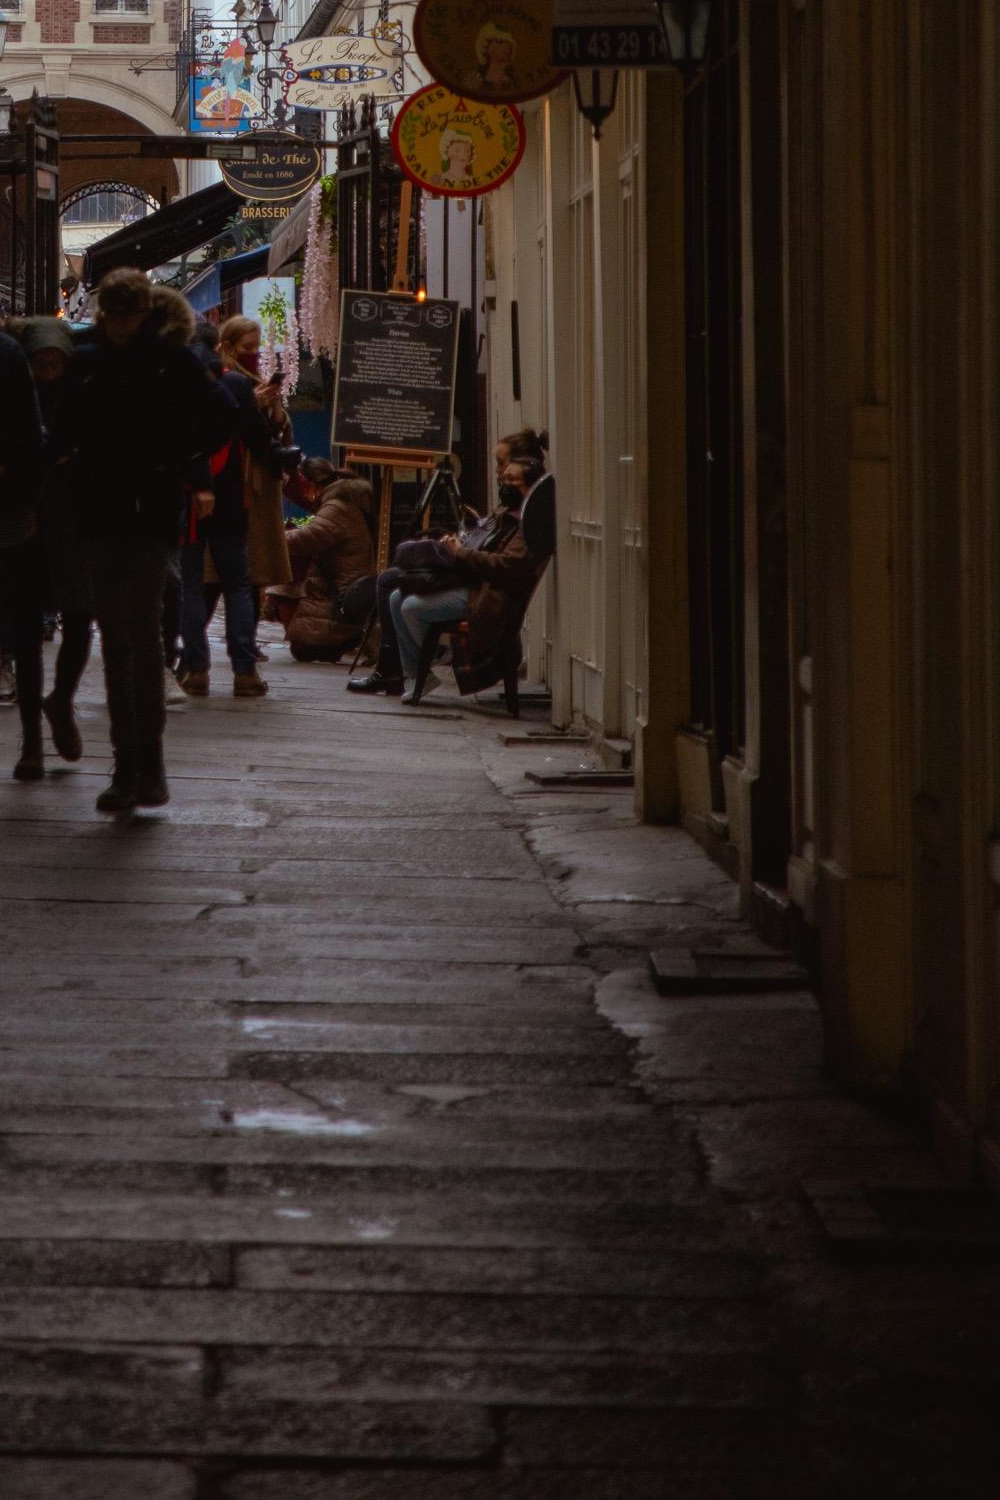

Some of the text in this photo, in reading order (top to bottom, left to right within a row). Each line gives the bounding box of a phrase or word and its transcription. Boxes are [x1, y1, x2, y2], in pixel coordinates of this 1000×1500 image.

[558, 32, 580, 59] 01
[587, 31, 612, 58] 43
[616, 31, 640, 57] 29
[296, 37, 384, 67] Le Procope
[262, 153, 281, 165] de
[282, 152, 312, 165] Thé
[242, 170, 263, 179] fondé
[275, 170, 295, 179] 1686
[460, 177, 482, 189] DE
